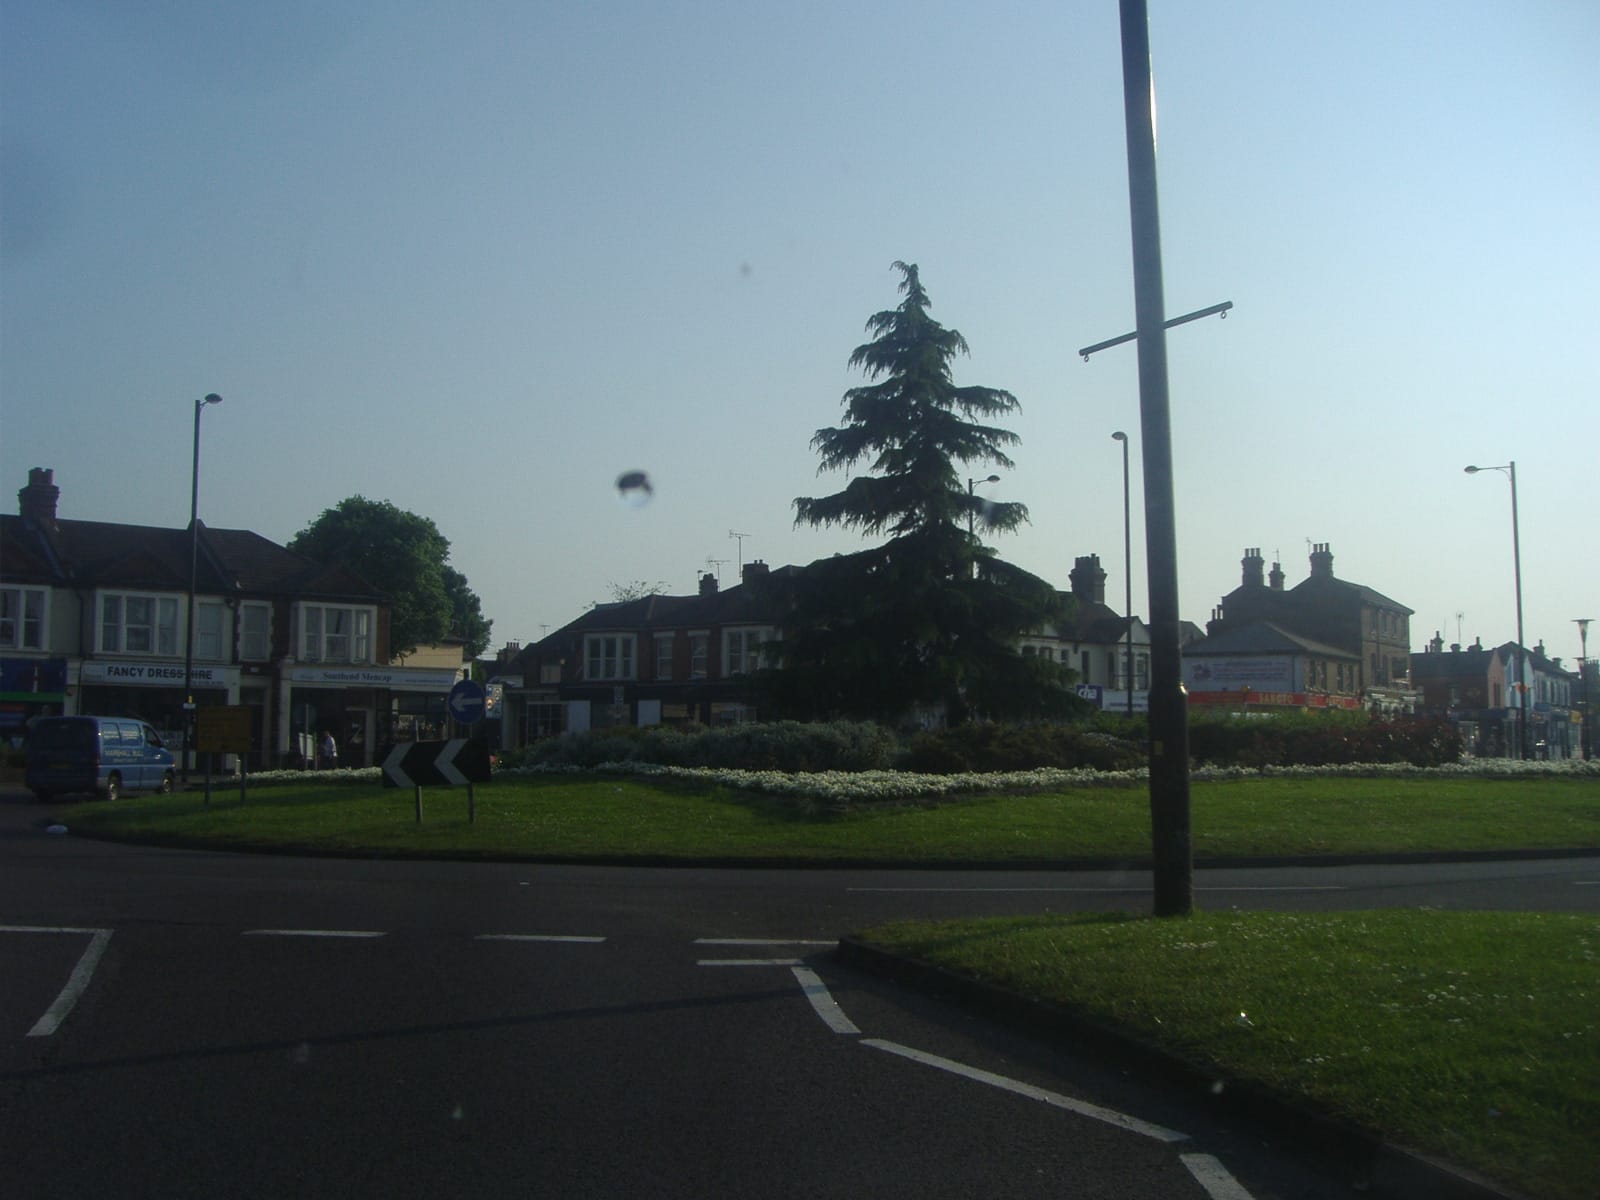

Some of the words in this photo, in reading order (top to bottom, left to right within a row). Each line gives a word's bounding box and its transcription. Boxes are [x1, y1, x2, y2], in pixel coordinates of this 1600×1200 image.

[107, 666, 144, 677] FANCY
[148, 668, 184, 679] DRESS
[322, 671, 360, 681] Southend
[362, 672, 392, 682] Mencap
